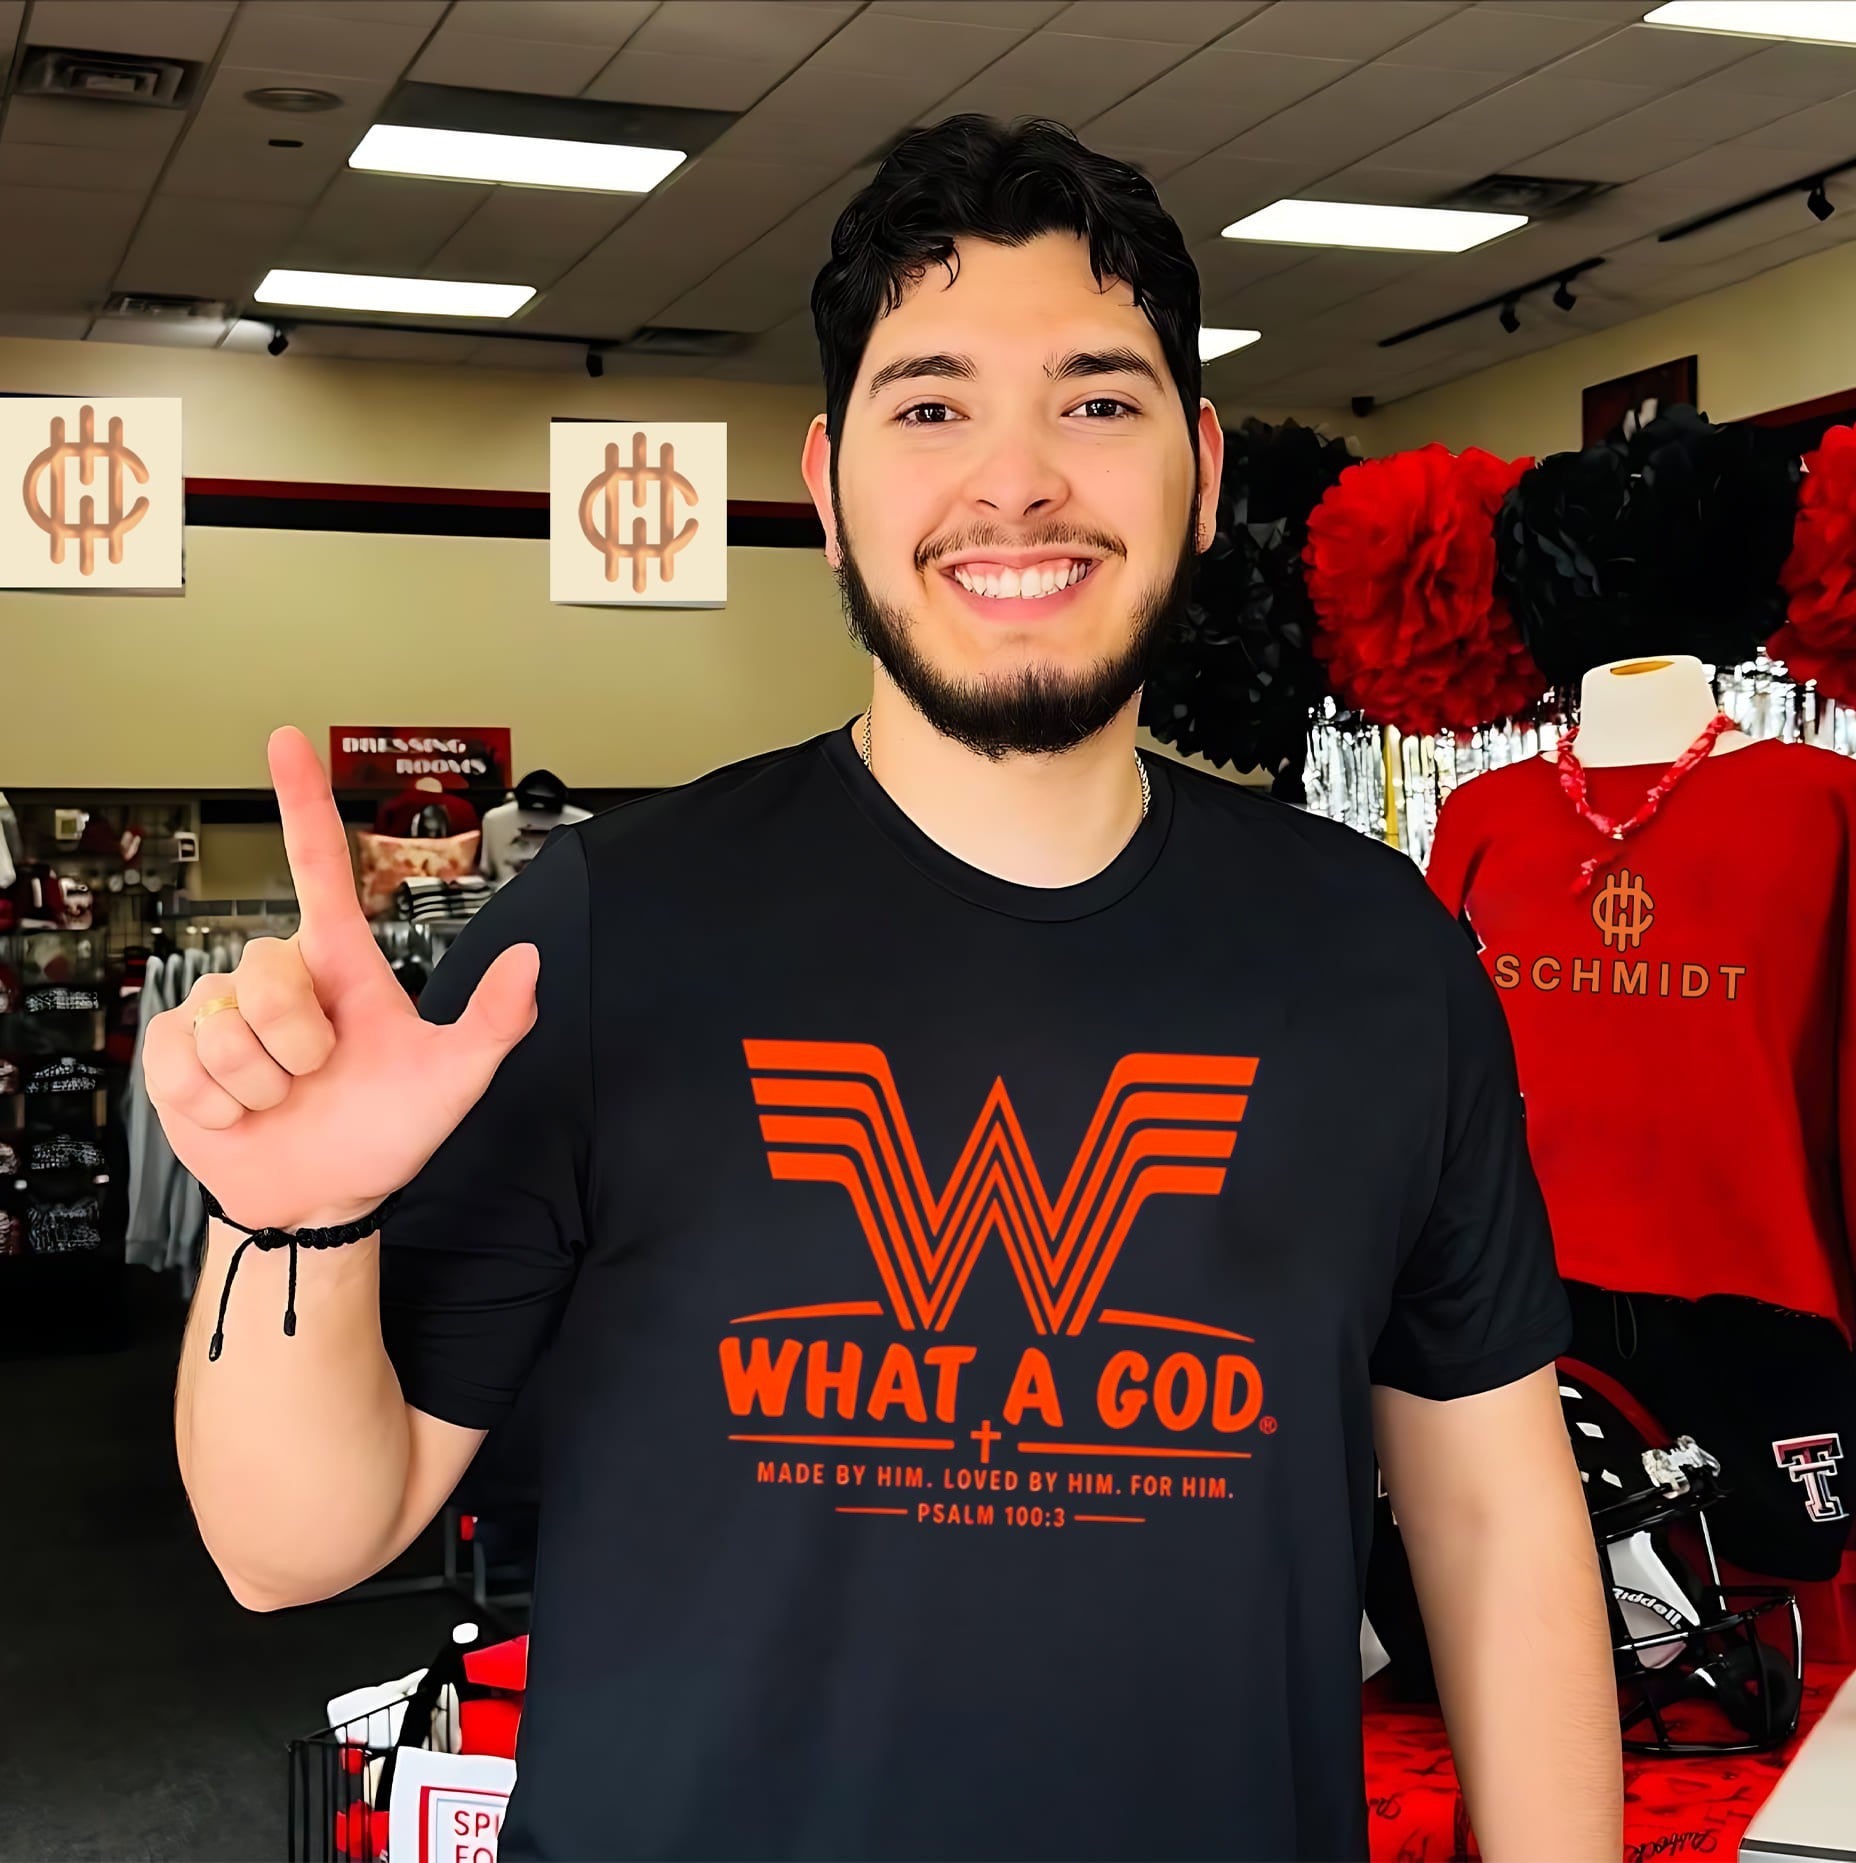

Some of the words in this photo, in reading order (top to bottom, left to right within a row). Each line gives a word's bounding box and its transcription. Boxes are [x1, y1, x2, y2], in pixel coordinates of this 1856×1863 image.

[342, 737, 467, 754] DRESSING
[396, 757, 487, 775] ROOMS
[1494, 953, 1747, 1000] SCHMIDT
[718, 1336, 978, 1424] WHAT
[1002, 1347, 1064, 1428] A
[1096, 1349, 1264, 1433] GOD
[757, 1461, 824, 1485] MADE
[836, 1464, 866, 1485] BY
[877, 1466, 933, 1489] HIM.
[943, 1468, 1018, 1491] LOVED
[1029, 1470, 1058, 1492] BY
[1068, 1473, 1122, 1495] HIM.
[1130, 1475, 1173, 1497] FOR
[1182, 1477, 1234, 1498] HIM.
[917, 1502, 994, 1525] PSALM
[1005, 1506, 1065, 1528] 100:3
